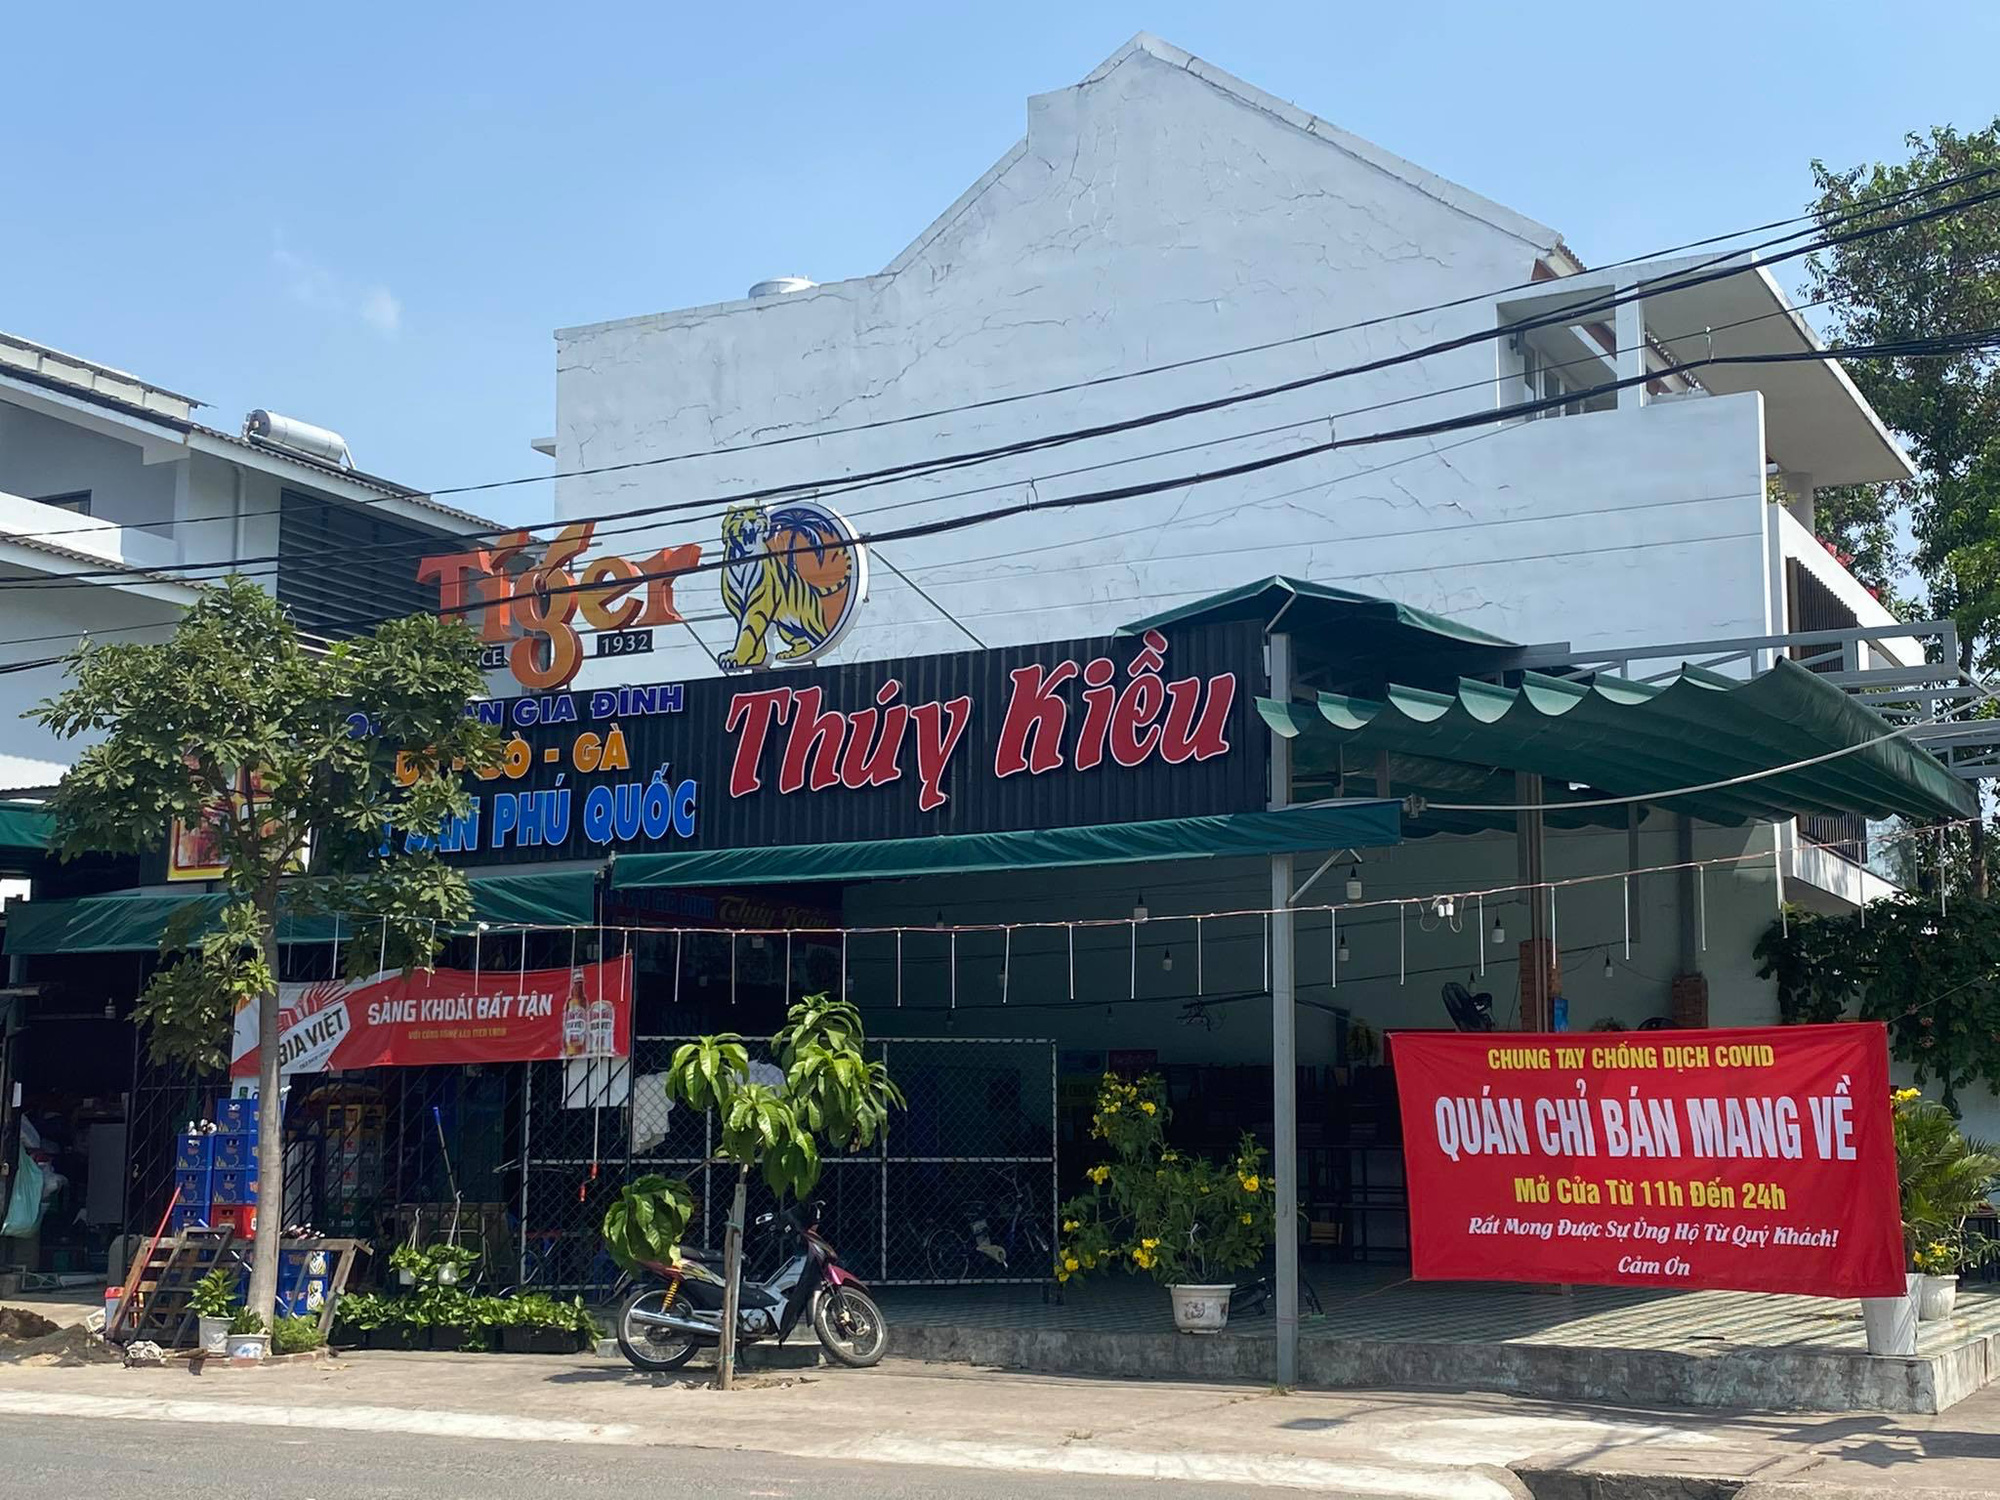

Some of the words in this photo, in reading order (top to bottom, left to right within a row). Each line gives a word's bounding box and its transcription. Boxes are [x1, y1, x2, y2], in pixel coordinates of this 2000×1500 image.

[416, 521, 702, 690] Tiger
[601, 634, 649, 654] 1932
[512, 694, 578, 726] GIA
[590, 683, 685, 720] ĐÌNH
[726, 679, 972, 811] Thúy
[995, 630, 1236, 778] Kiều
[572, 723, 631, 773] GÀ
[492, 773, 572, 848] PHÚ
[584, 762, 698, 847] QUỐC
[421, 993, 473, 1021] KHOÁI
[477, 990, 513, 1018] BẤT
[517, 991, 554, 1020] TẬN
[305, 1007, 345, 1048] VIỆT
[1488, 1048, 1550, 1070] CHUNG
[1556, 1048, 1586, 1069] TAY
[1592, 1040, 1657, 1069] CHỐNG
[1663, 1045, 1710, 1073] DỊCH
[1715, 1044, 1774, 1068] COVID
[1435, 1085, 1531, 1161] QUÁN
[1535, 1079, 1596, 1157] CHỈ
[1603, 1086, 1681, 1158] BÁN
[1687, 1096, 1802, 1160] MANG
[1809, 1074, 1857, 1161] VỀ
[1514, 1176, 1551, 1203] Mở
[1557, 1176, 1601, 1204] Cửa
[1605, 1179, 1635, 1206] Từ
[1640, 1180, 1683, 1207] 11h
[1689, 1176, 1736, 1209] Đến
[1741, 1182, 1787, 1210] 24h
[1468, 1214, 1501, 1235] Rất
[1503, 1218, 1554, 1240] Mong
[1557, 1218, 1603, 1242] Được
[1605, 1220, 1631, 1243] Sự
[1633, 1216, 1670, 1245] Ủng
[1674, 1222, 1700, 1245] Hộ
[1704, 1222, 1730, 1242] Từ
[1732, 1224, 1770, 1248] Quý
[1773, 1226, 1840, 1248] Khách!
[1618, 1255, 1660, 1274] Cảm
[1664, 1256, 1691, 1276] Ơn
